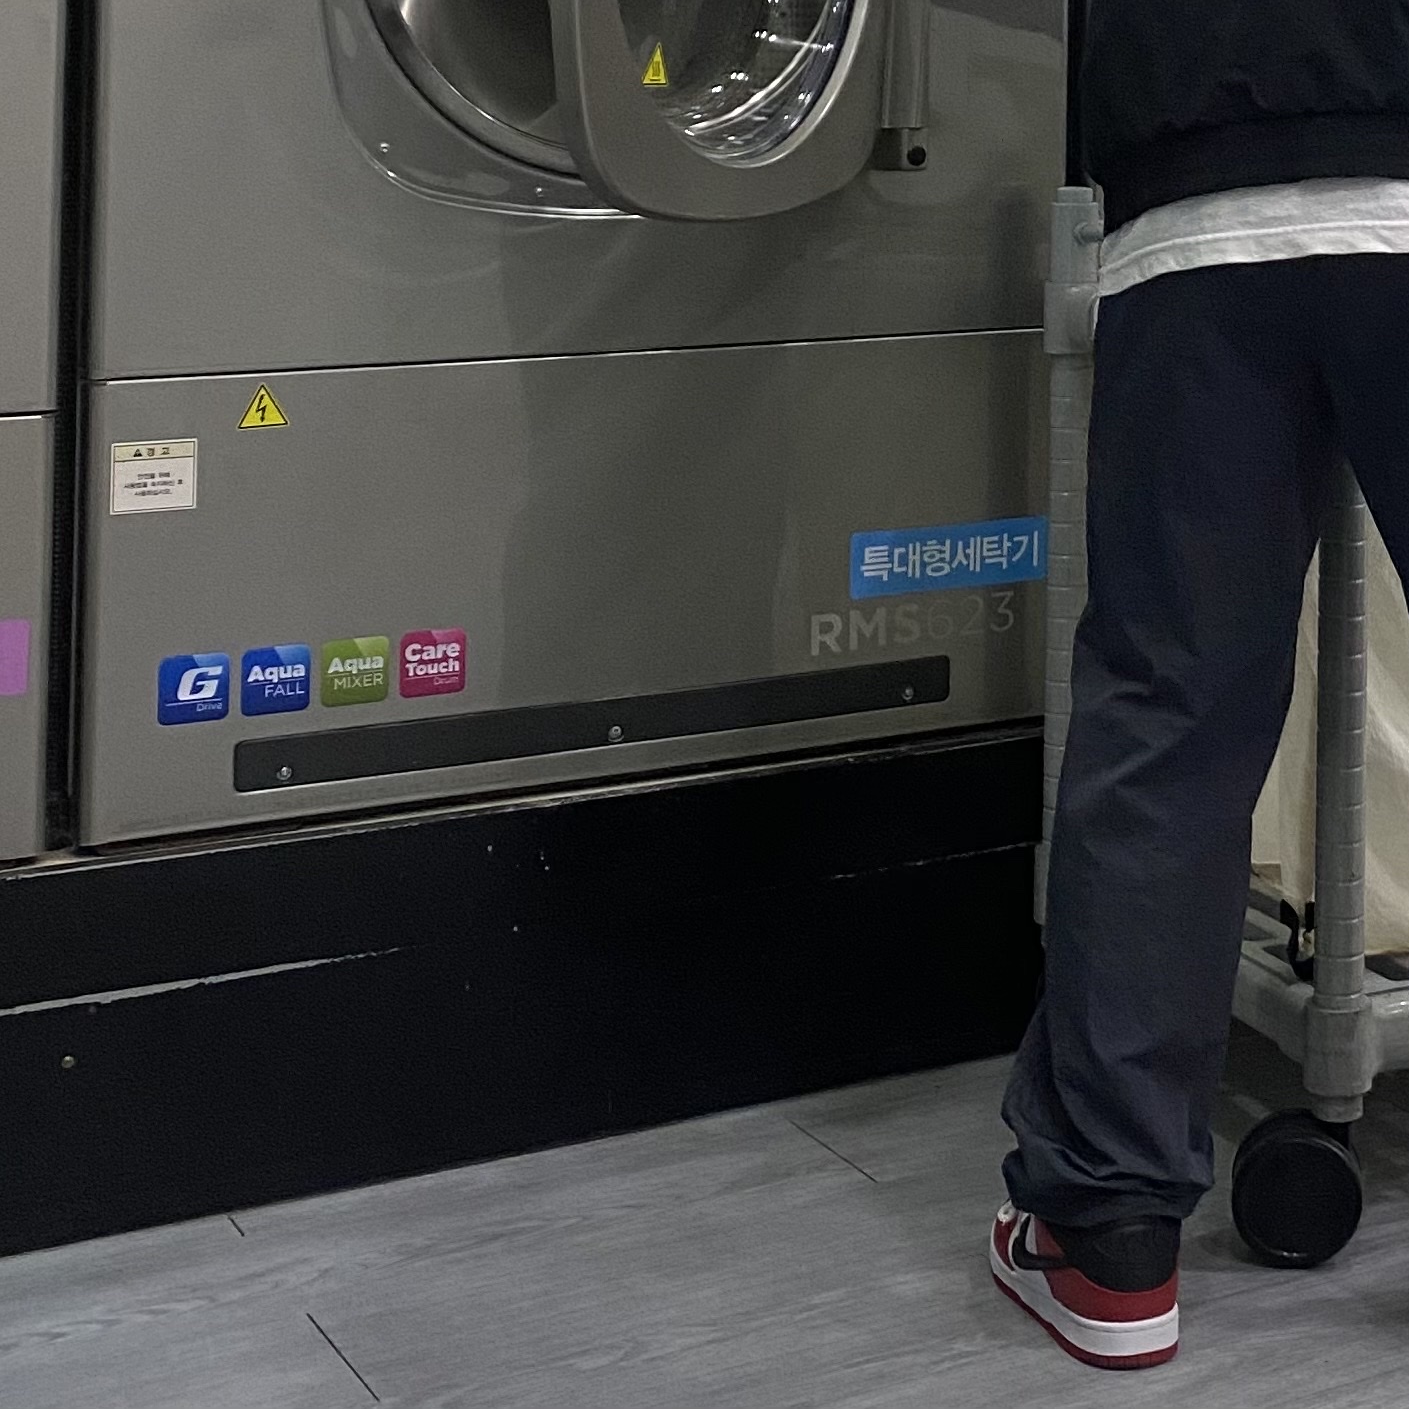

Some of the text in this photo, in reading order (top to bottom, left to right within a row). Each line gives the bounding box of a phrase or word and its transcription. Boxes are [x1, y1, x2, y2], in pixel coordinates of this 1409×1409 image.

[860, 530, 1039, 581] 특대형세탁기
[405, 642, 460, 662] Care
[247, 663, 305, 682] Aqua
[327, 656, 384, 674] Aqua
[405, 658, 460, 677] Touch
[177, 666, 223, 701] G
[265, 682, 305, 698] FALL
[334, 673, 383, 690] MIXER
